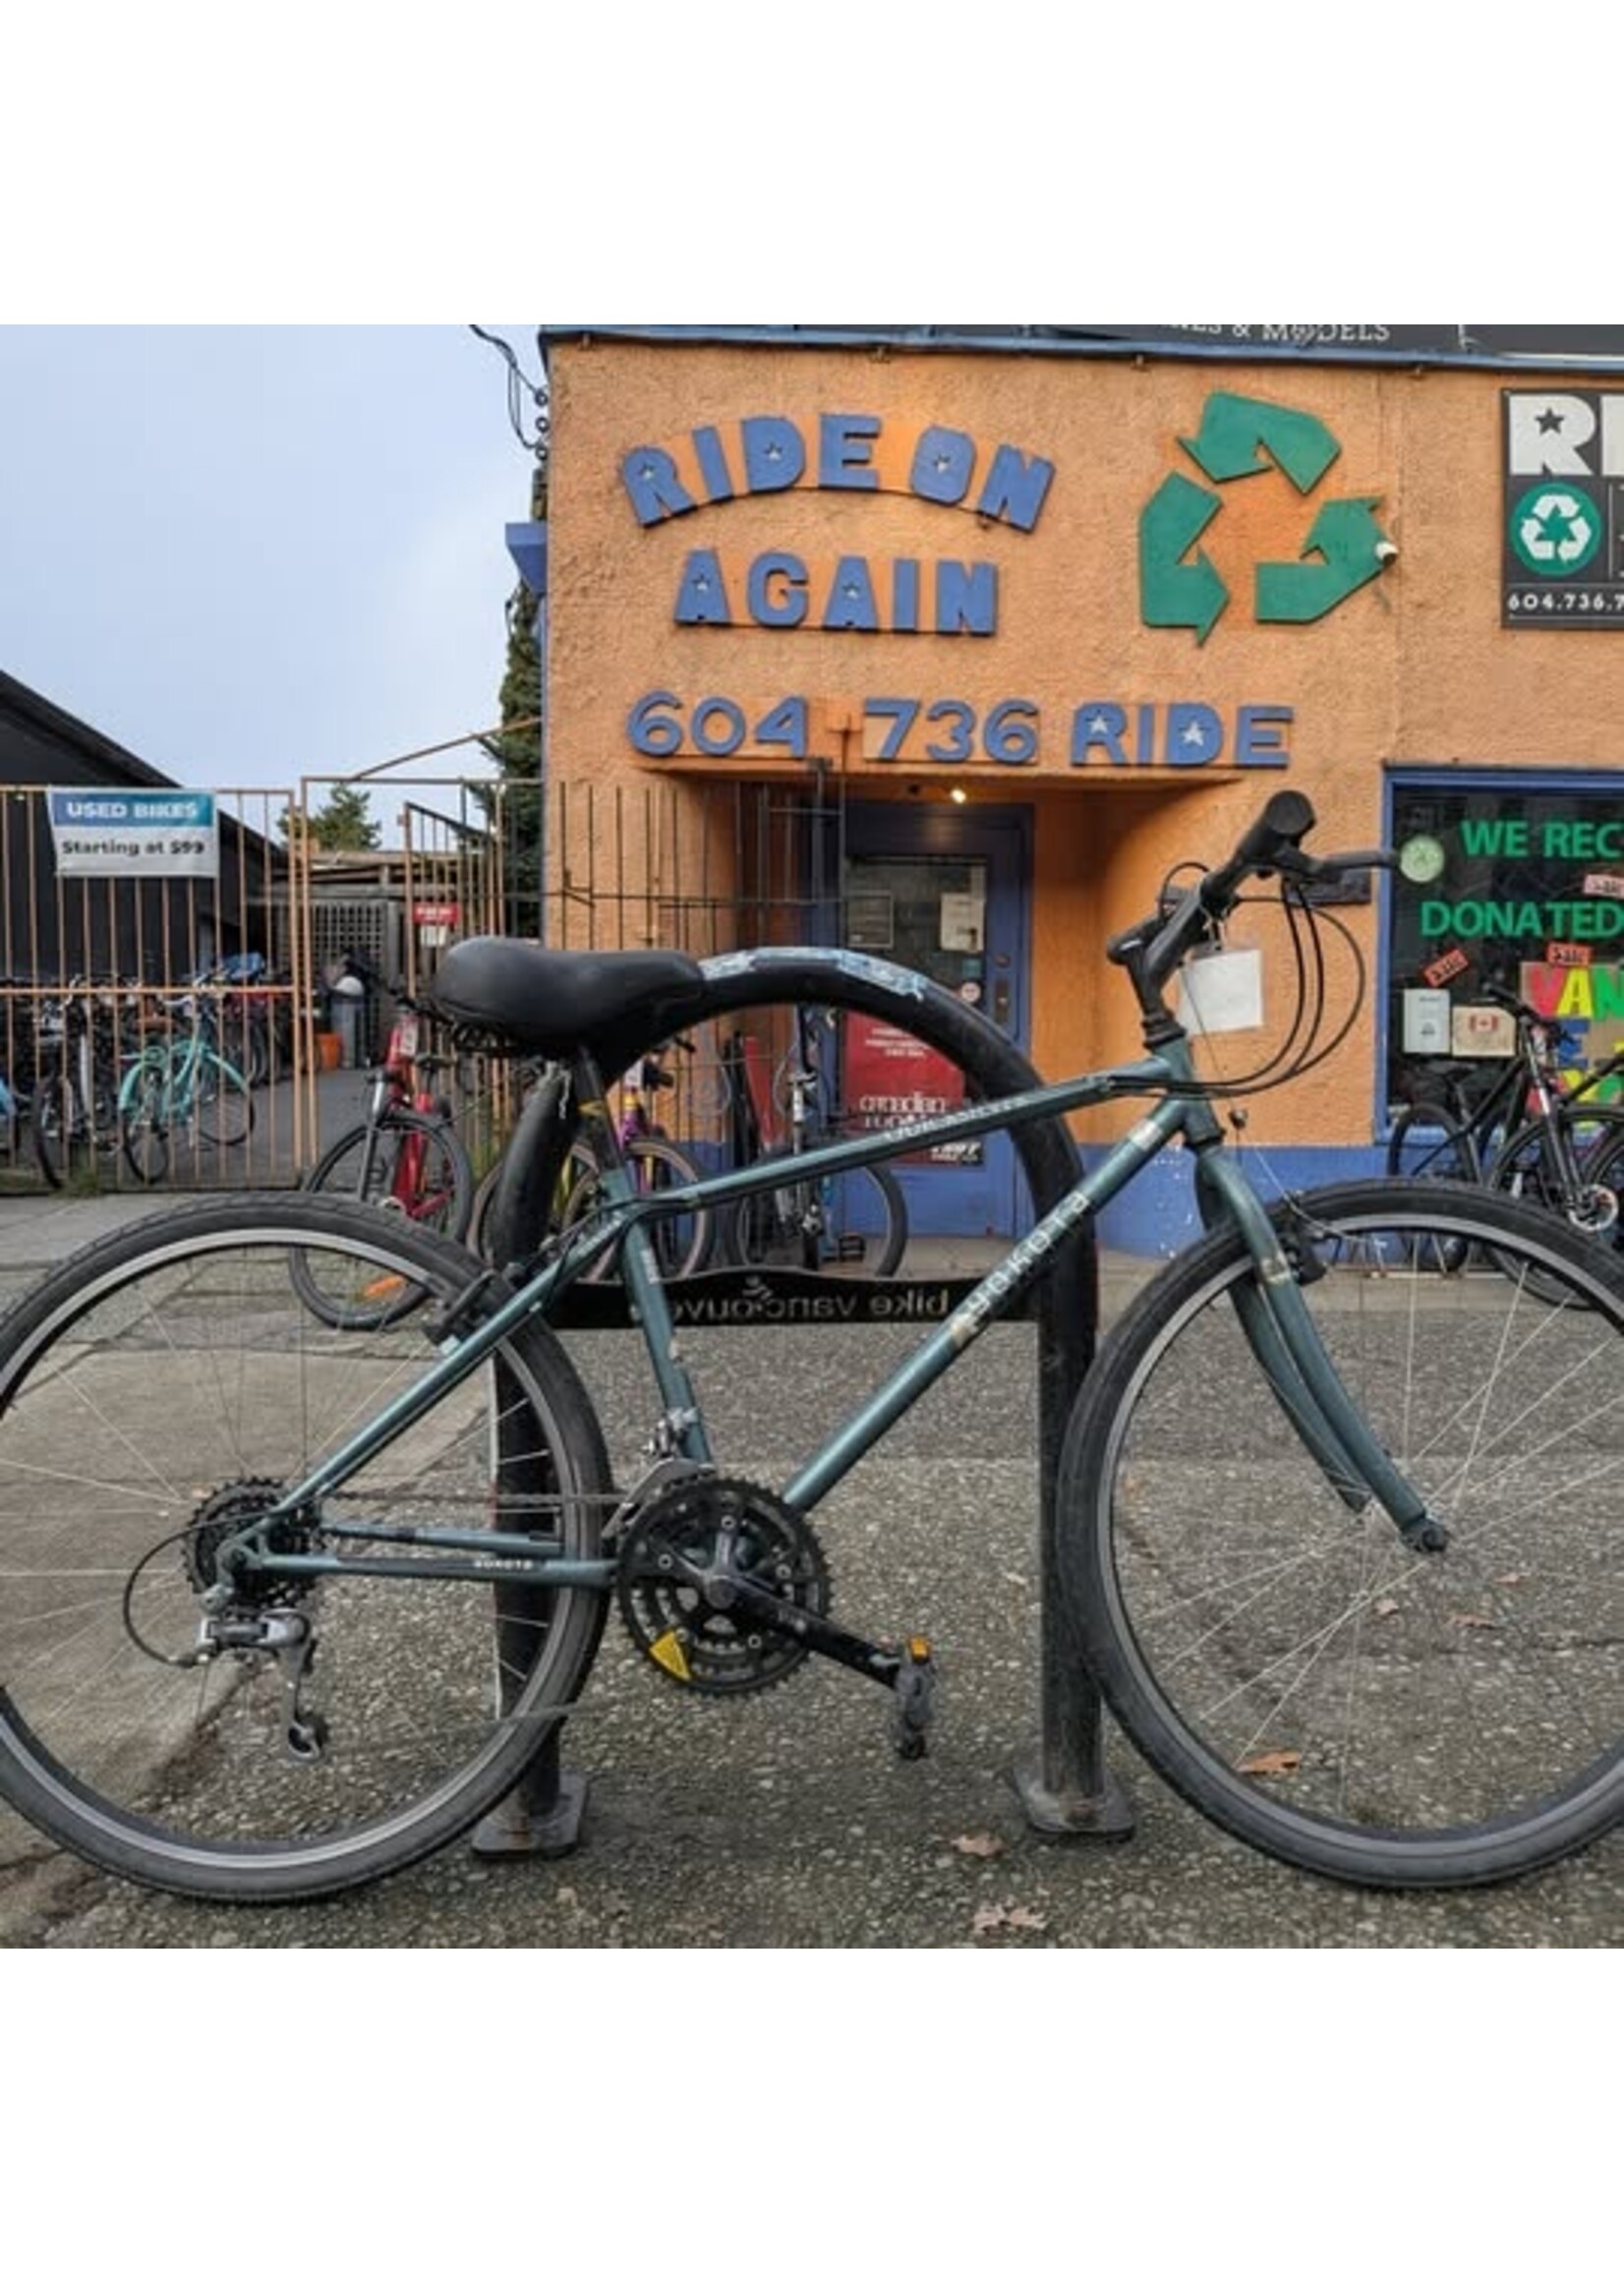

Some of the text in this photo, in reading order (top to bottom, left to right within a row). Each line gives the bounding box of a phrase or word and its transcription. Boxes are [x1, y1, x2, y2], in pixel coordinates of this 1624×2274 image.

[621, 413, 1056, 533] RIDE ON
[673, 548, 998, 636] AGAIN
[626, 690, 1293, 767] 604 736 RIDE
[67, 801, 198, 818] USED BIKES
[62, 840, 140, 857] Starting
[145, 841, 164, 854] at
[1461, 821, 1622, 858] WE REC
[1421, 901, 1624, 937] DONATED
